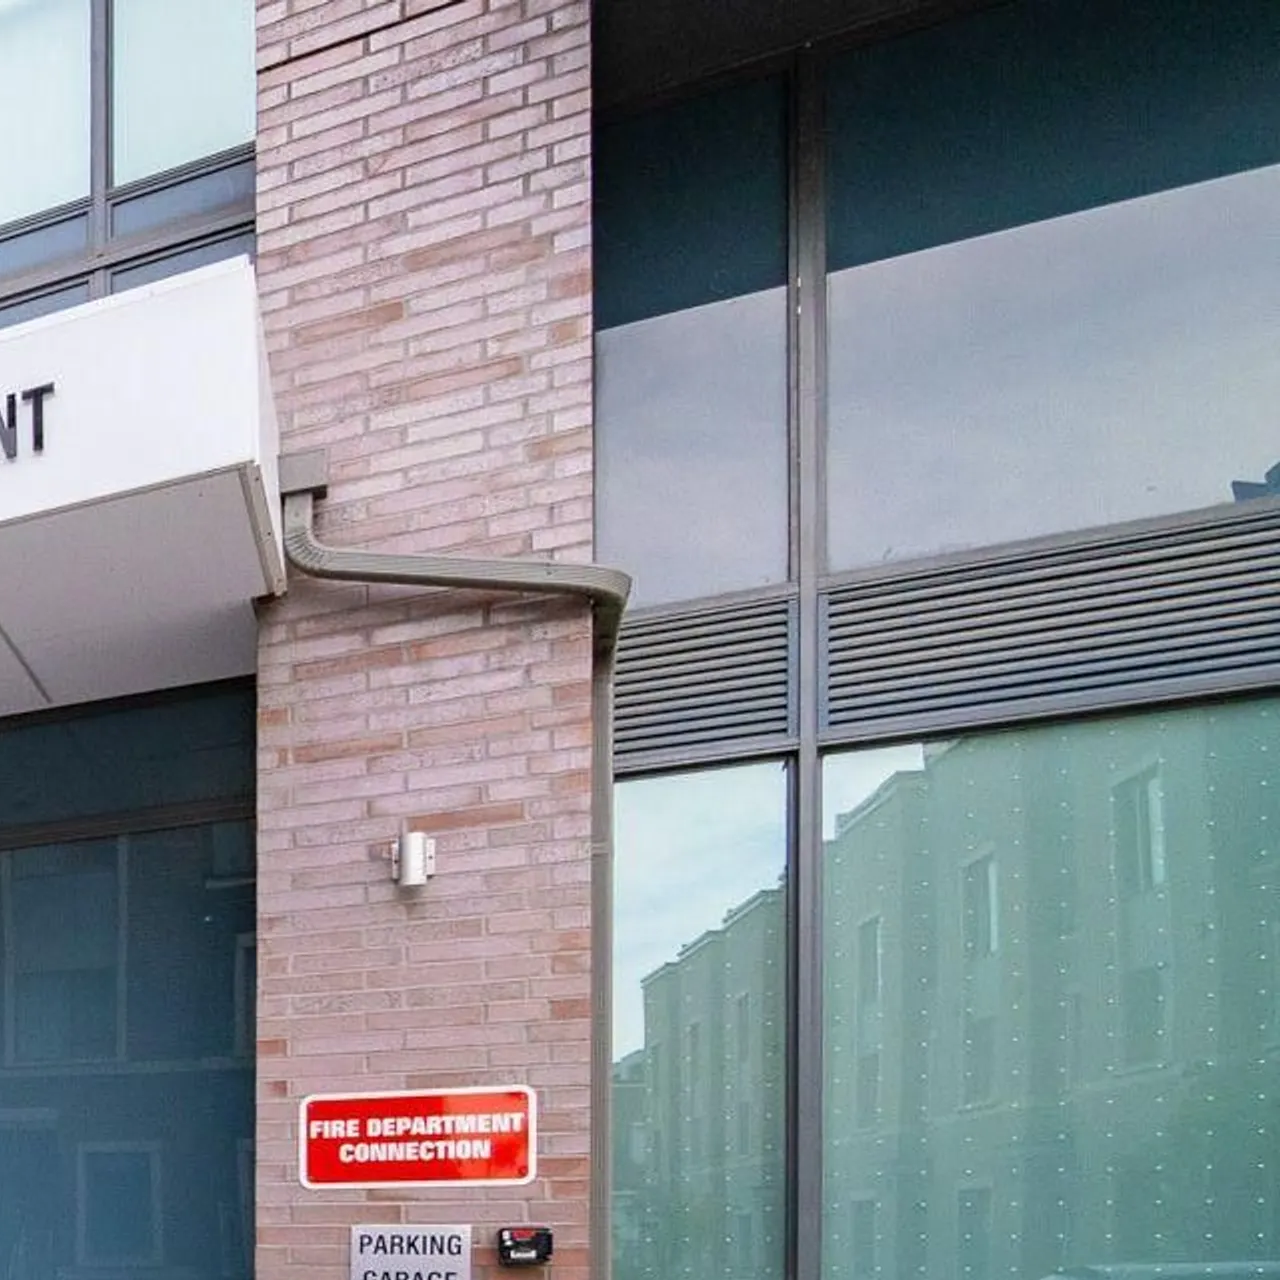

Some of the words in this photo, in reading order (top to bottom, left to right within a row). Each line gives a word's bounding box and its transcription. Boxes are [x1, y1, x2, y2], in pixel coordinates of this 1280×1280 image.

[309, 1119, 361, 1139] FIRE
[366, 1112, 525, 1138] DEPARTMENT
[339, 1139, 492, 1163] CONNECTION
[358, 1233, 463, 1257] PARKING
